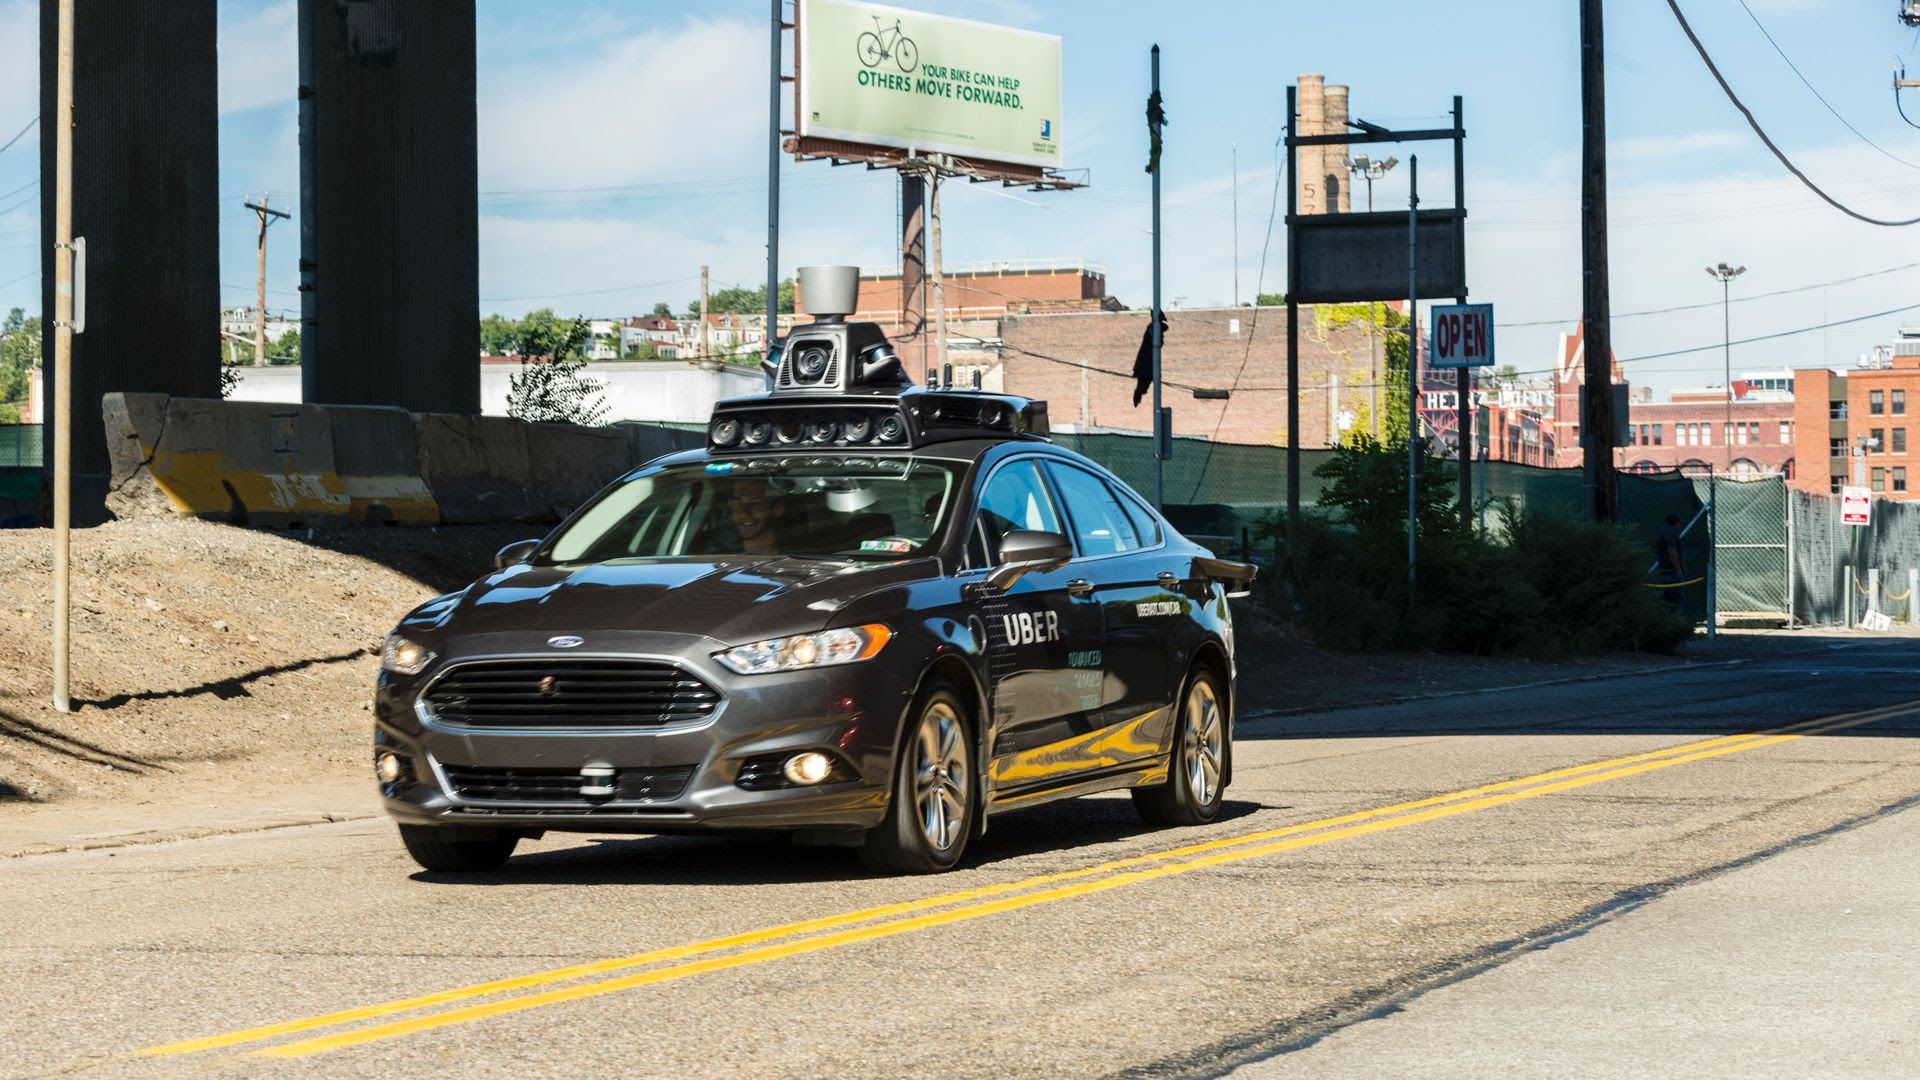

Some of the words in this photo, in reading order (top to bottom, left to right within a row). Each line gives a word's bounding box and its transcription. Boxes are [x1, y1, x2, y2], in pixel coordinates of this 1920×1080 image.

[858, 69, 911, 92] OTHERS
[915, 78, 952, 98] MOVE
[956, 85, 1023, 110] FORWARD.
[922, 63, 947, 79] YOUR
[950, 68, 971, 83] BIKE
[974, 72, 995, 87] CAN
[998, 76, 1020, 91] HELP
[1437, 313, 1487, 359] OPEN
[1003, 610, 1060, 647] UBER
